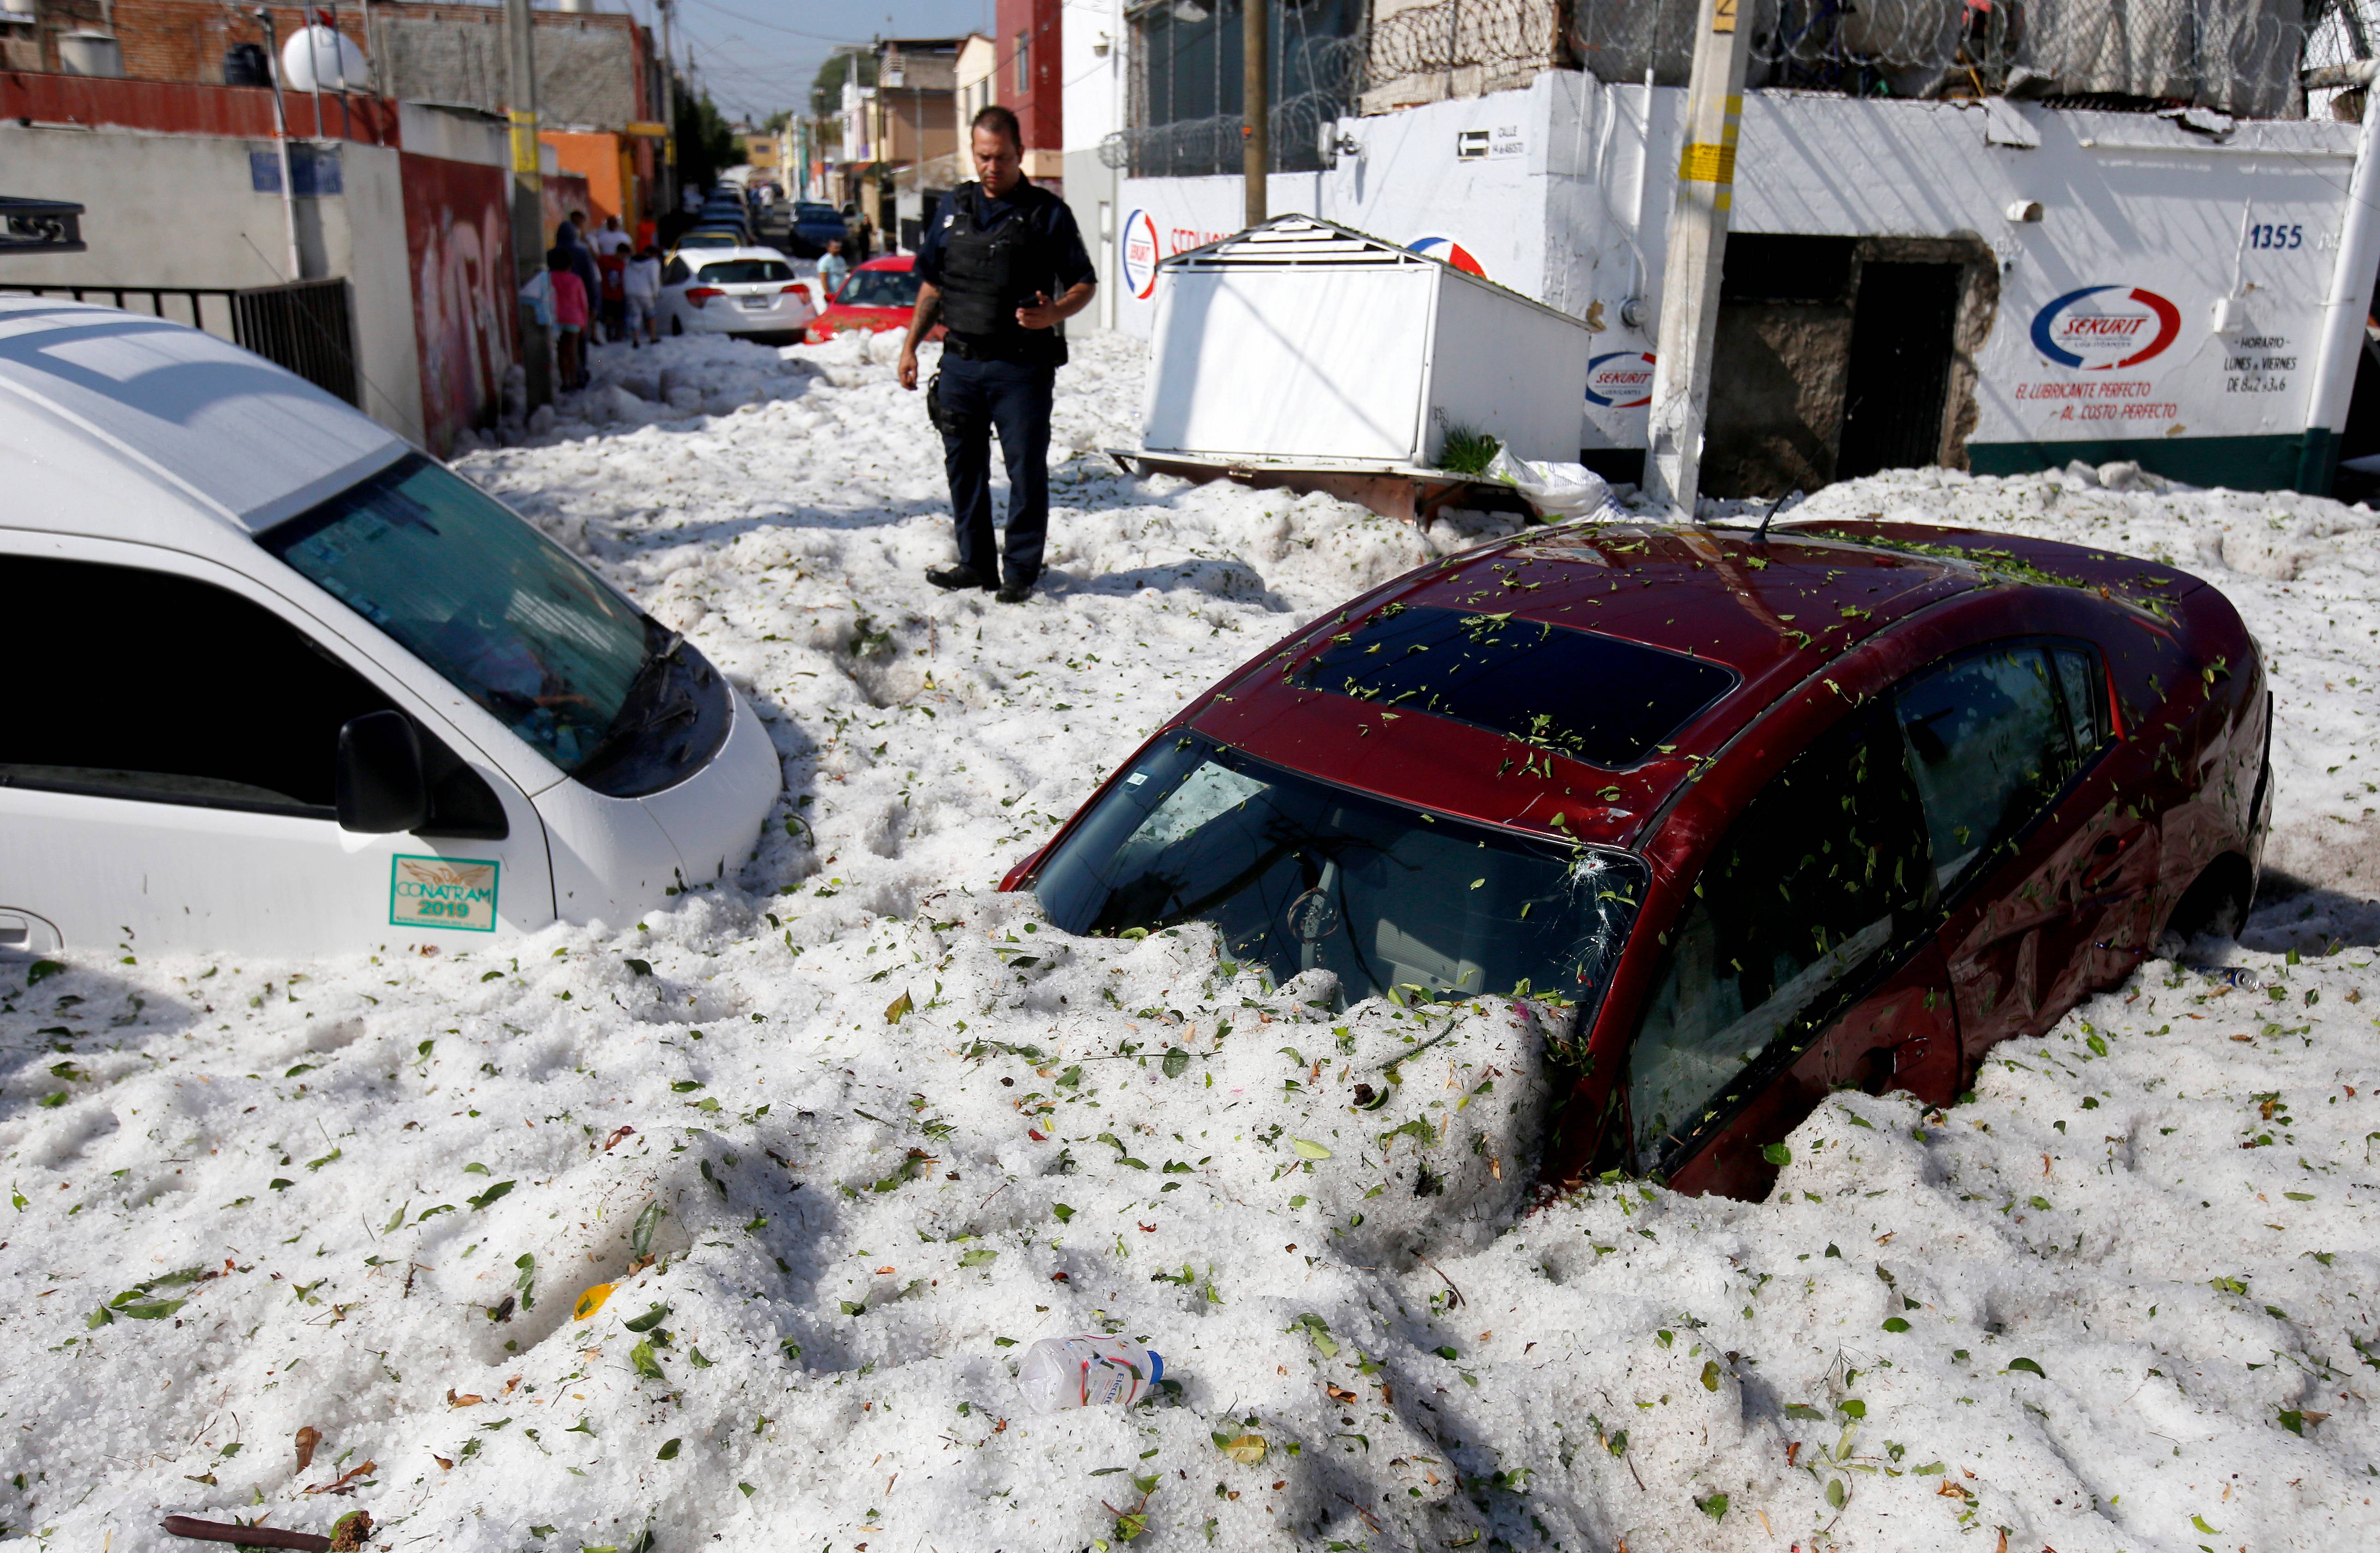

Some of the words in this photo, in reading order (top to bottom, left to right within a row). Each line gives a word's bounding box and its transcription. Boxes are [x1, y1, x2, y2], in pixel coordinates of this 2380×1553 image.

[1498, 125, 1517, 137] CALLE
[2251, 224, 2302, 249] 1355
[2063, 317, 2148, 335] SEKURIT
[2224, 356, 2251, 371] LUNES
[2262, 356, 2297, 371] VIERNES
[1596, 372, 1652, 384] SEKURIT
[2227, 376, 2239, 392] DE
[2015, 383, 2027, 399] EL
[2029, 382, 2097, 399] LUBRICANTE
[2098, 381, 2152, 398] PERFECTO
[2060, 405, 2074, 420] AL
[2081, 403, 2117, 420] COSTO
[2122, 402, 2177, 419] PERFECTO
[397, 881, 491, 903] CONATRAM
[418, 900, 470, 919] 2019
